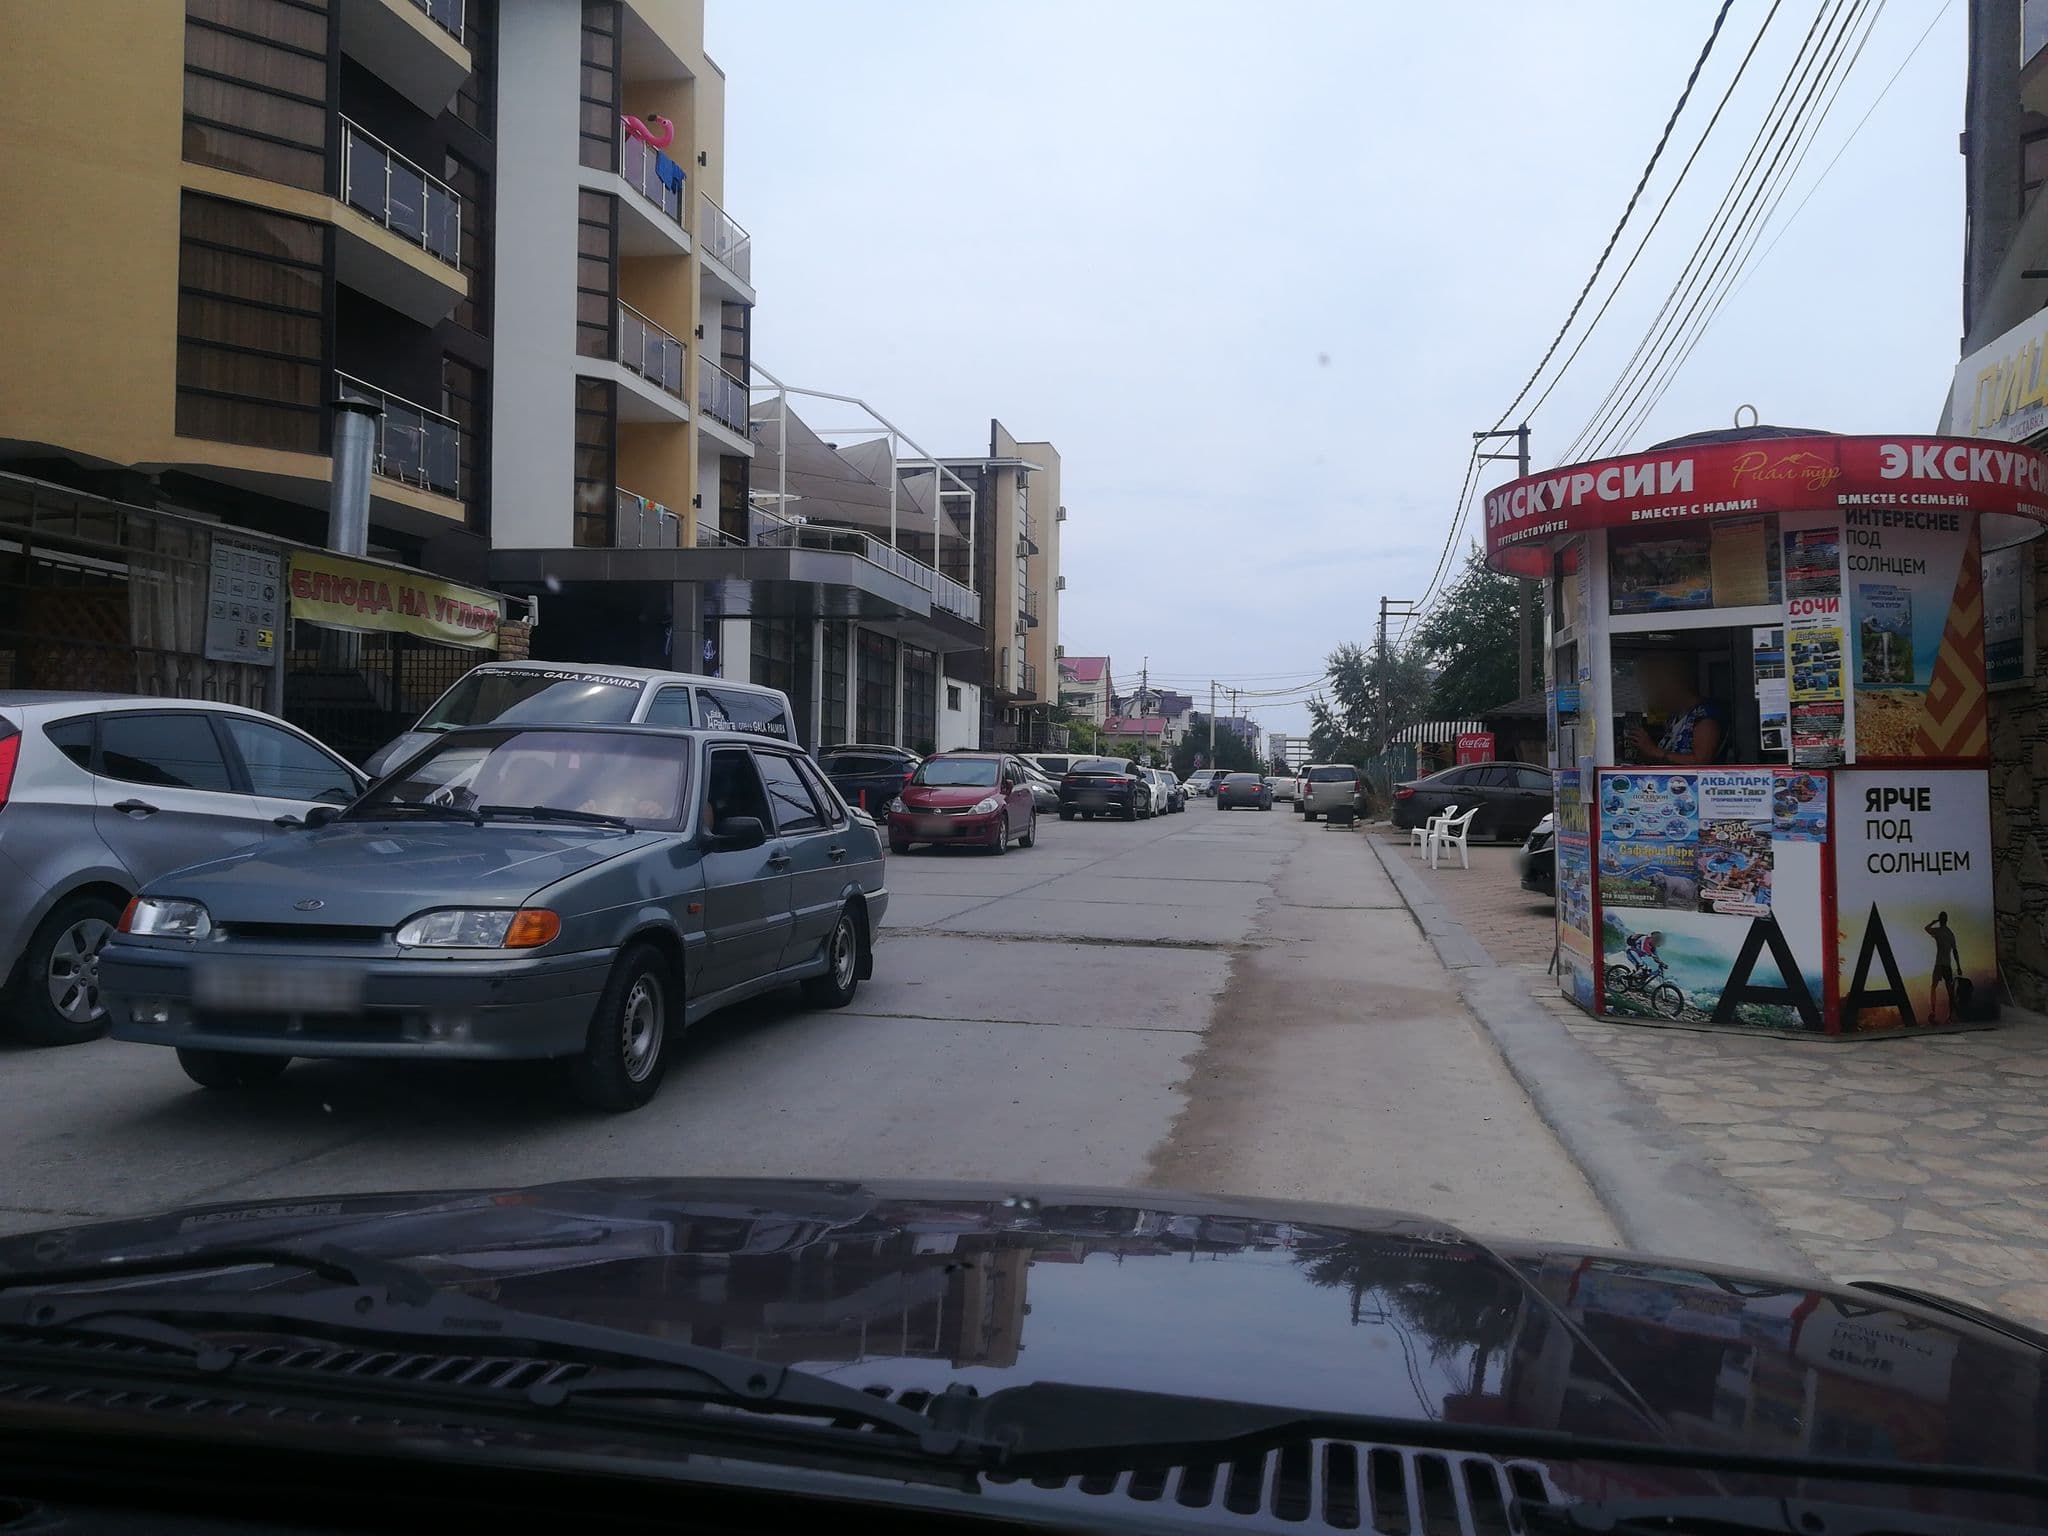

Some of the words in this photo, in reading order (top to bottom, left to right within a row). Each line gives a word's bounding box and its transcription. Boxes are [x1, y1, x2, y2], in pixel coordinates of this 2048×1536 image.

[1488, 459, 1694, 529] ЭКСКУРСИИ
[1838, 494, 1896, 505] ВМЕСТЕ
[1899, 494, 1908, 504] С
[1911, 493, 1969, 506] СЕМЬЕЙ!
[1631, 507, 1687, 521] ВМЕСТЕ
[1691, 503, 1700, 514] С
[1703, 499, 1758, 513] НАМИ!
[1845, 508, 1960, 532] ИНТЕРЕСНЕЕ
[1846, 530, 1881, 549] ПОД
[1847, 555, 1926, 576] СОЛНЦЕМ
[292, 568, 393, 615] БЛЮДА
[398, 586, 431, 619] НА
[433, 595, 497, 633] УГЛЯХ
[1789, 598, 1840, 616] СОЧИ
[543, 671, 579, 680] GALA
[582, 675, 641, 689] PALMIRA
[1701, 777, 1770, 786] АКВАПАРК
[1865, 787, 1932, 812] ЯРЧЕ
[1867, 819, 1912, 843] ПОД
[1867, 851, 1971, 876] СОЛНЦЕМ
